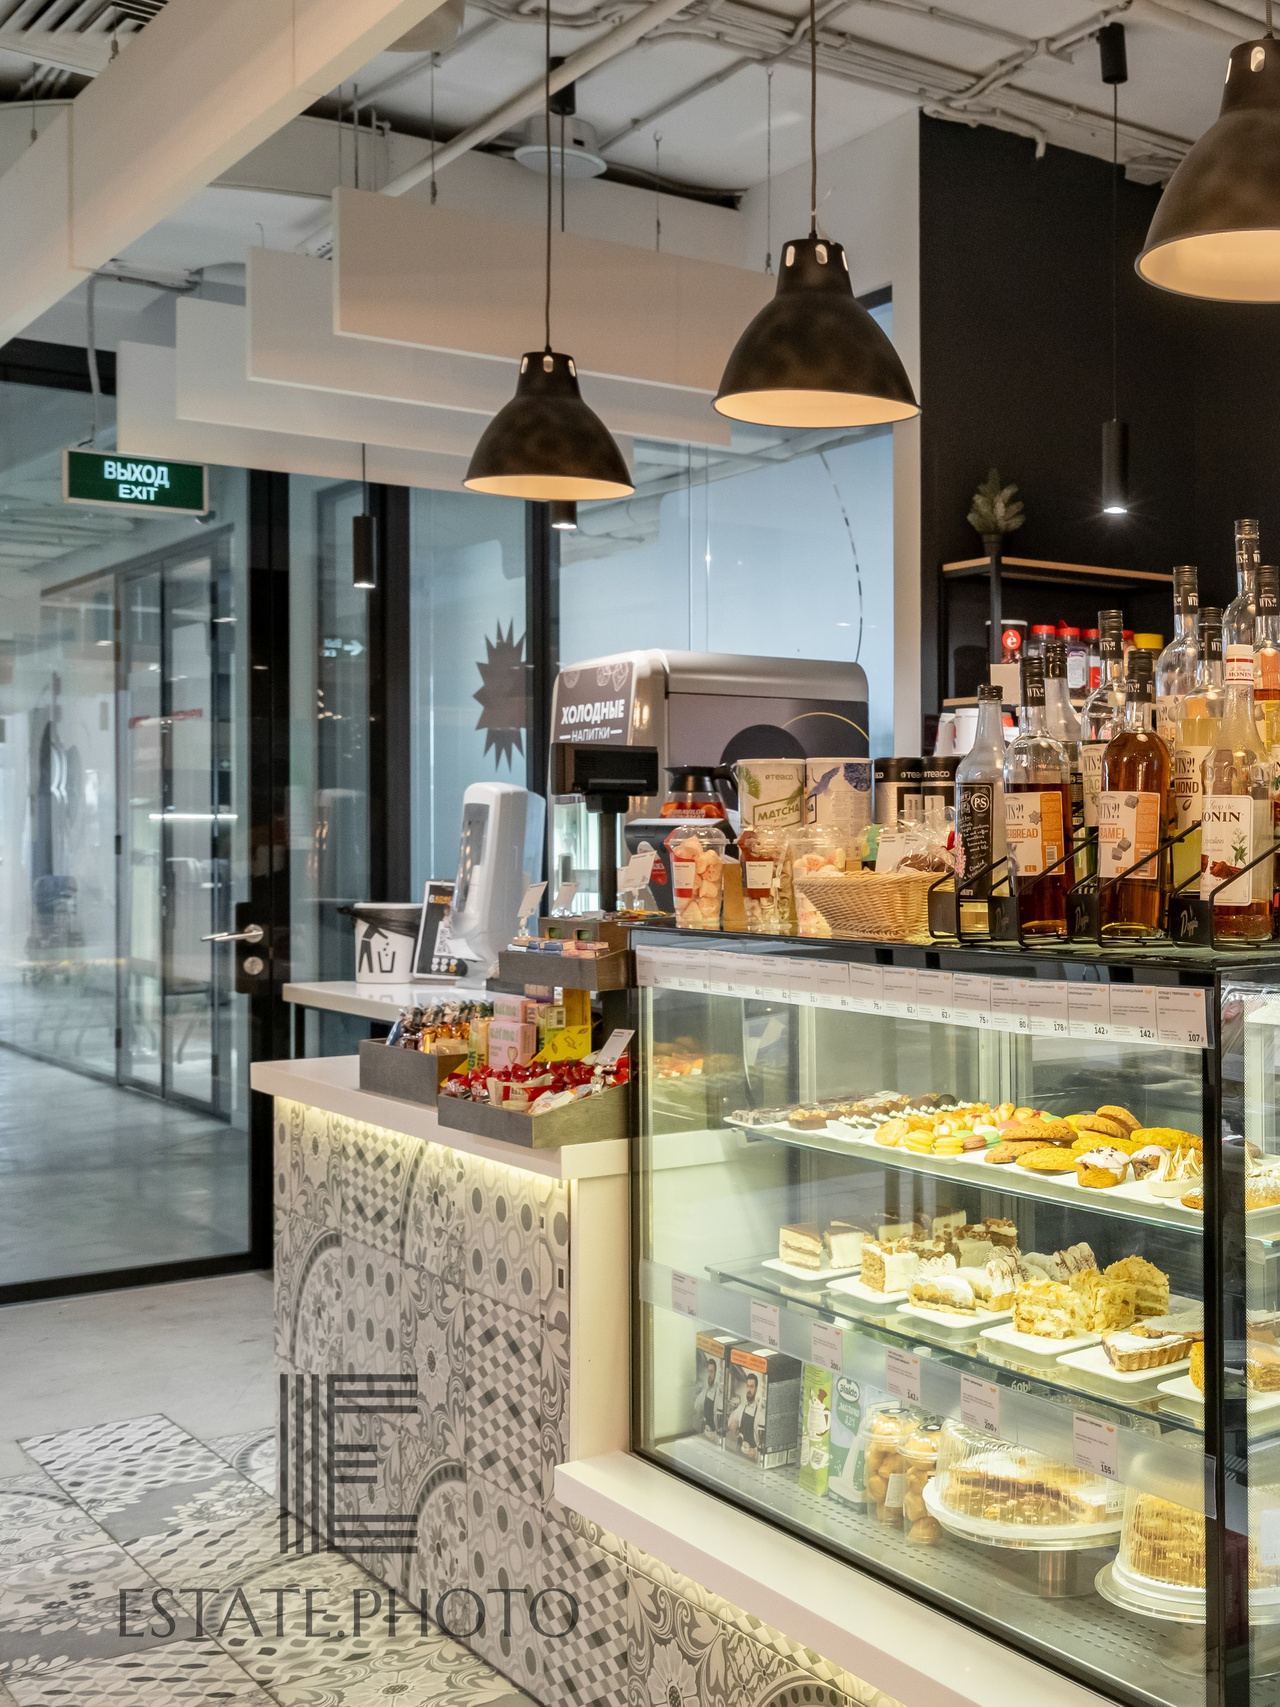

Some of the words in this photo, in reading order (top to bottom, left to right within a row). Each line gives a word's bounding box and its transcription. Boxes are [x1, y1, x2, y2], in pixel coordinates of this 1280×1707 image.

[104, 460, 170, 488] ВЫХОД
[119, 484, 158, 500] EXIT
[561, 698, 625, 725] ХОЛОДНЫЕ
[571, 727, 611, 743] НАПИТКИ
[757, 806, 799, 822] MATCHA
[1054, 1022, 1064, 1031] 178
[1094, 1026, 1105, 1035] 142
[1140, 1029, 1152, 1038] 142
[1188, 1033, 1200, 1043] 107
[984, 1421, 994, 1432] 200
[1101, 1464, 1112, 1475] 155
